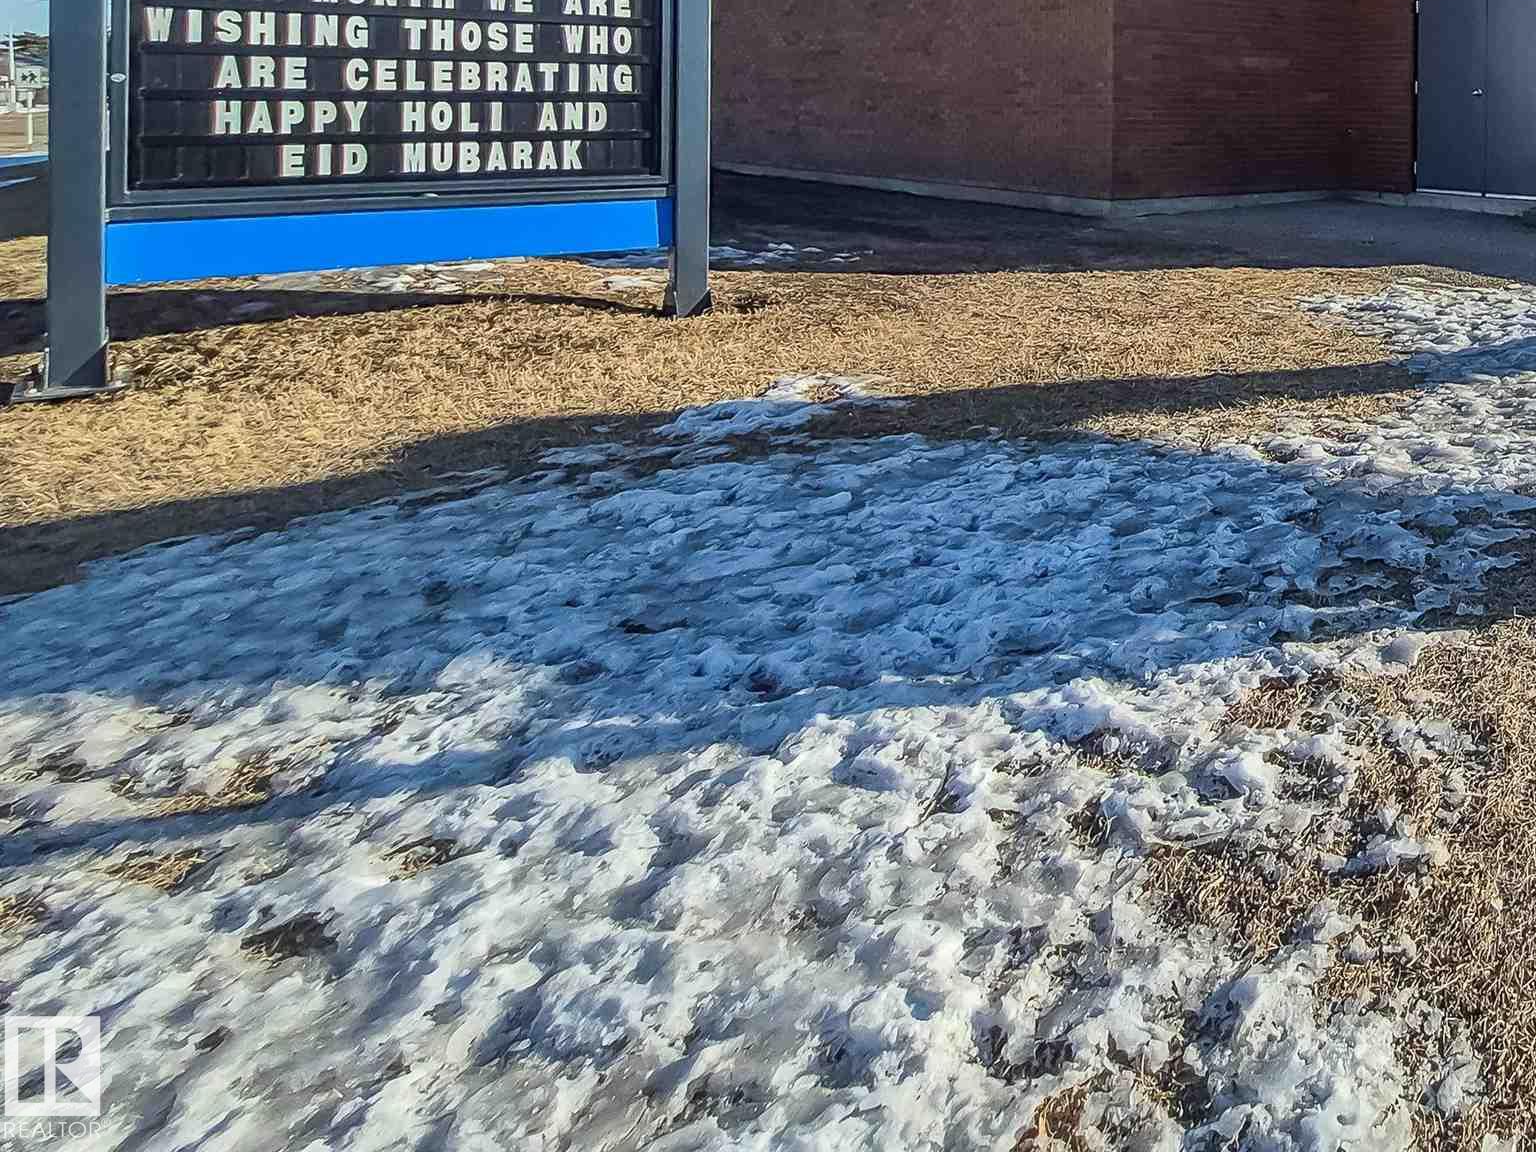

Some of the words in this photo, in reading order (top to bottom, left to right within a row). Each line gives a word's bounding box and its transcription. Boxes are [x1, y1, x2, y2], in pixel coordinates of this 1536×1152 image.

[145, 7, 369, 48] WISHING
[404, 19, 534, 53] THOSE
[562, 24, 632, 55] WHO
[214, 55, 307, 89] ARE
[346, 58, 633, 93] CELEBRATING
[214, 100, 368, 134] HAPPY
[402, 101, 503, 132] HOLI
[537, 101, 608, 131] AND
[281, 143, 368, 176] EID
[402, 140, 583, 173] MUBARAK
